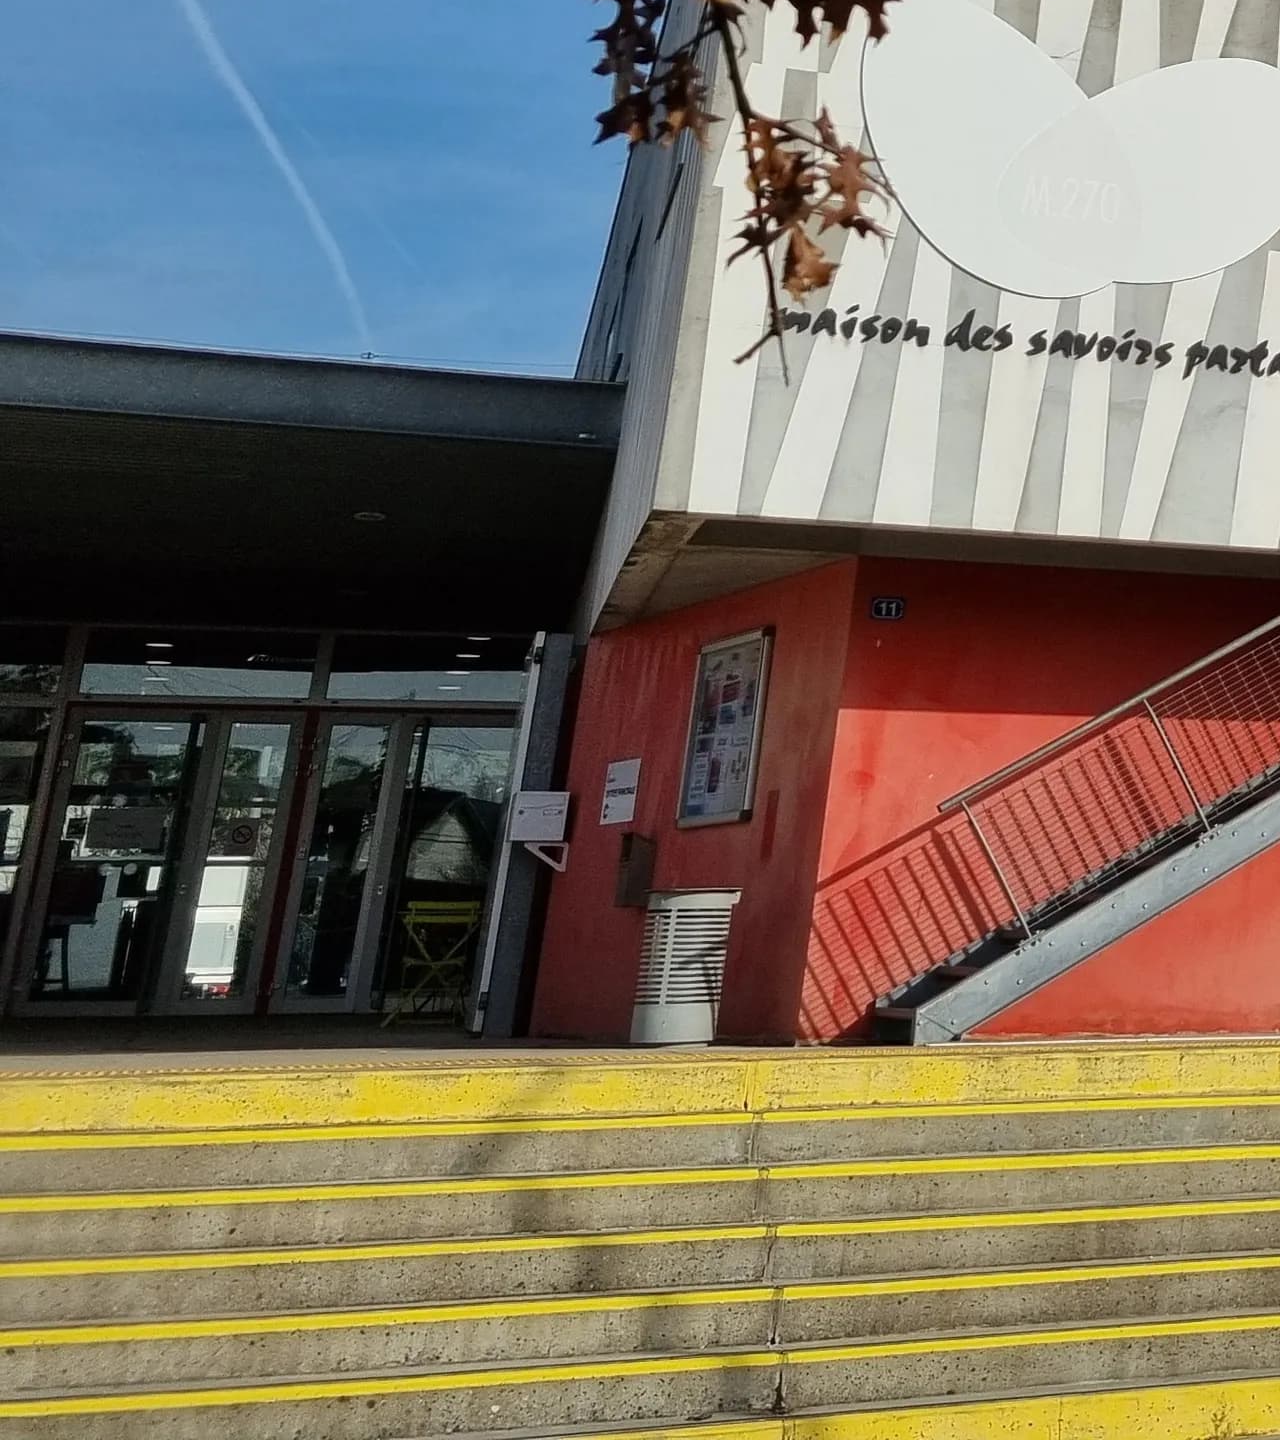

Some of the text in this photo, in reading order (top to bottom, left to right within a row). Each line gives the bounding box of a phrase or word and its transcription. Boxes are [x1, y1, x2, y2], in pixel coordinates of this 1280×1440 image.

[776, 304, 930, 348] maison
[944, 308, 1013, 352] des
[1025, 329, 1175, 369] savoirs
[880, 601, 897, 616] 11
